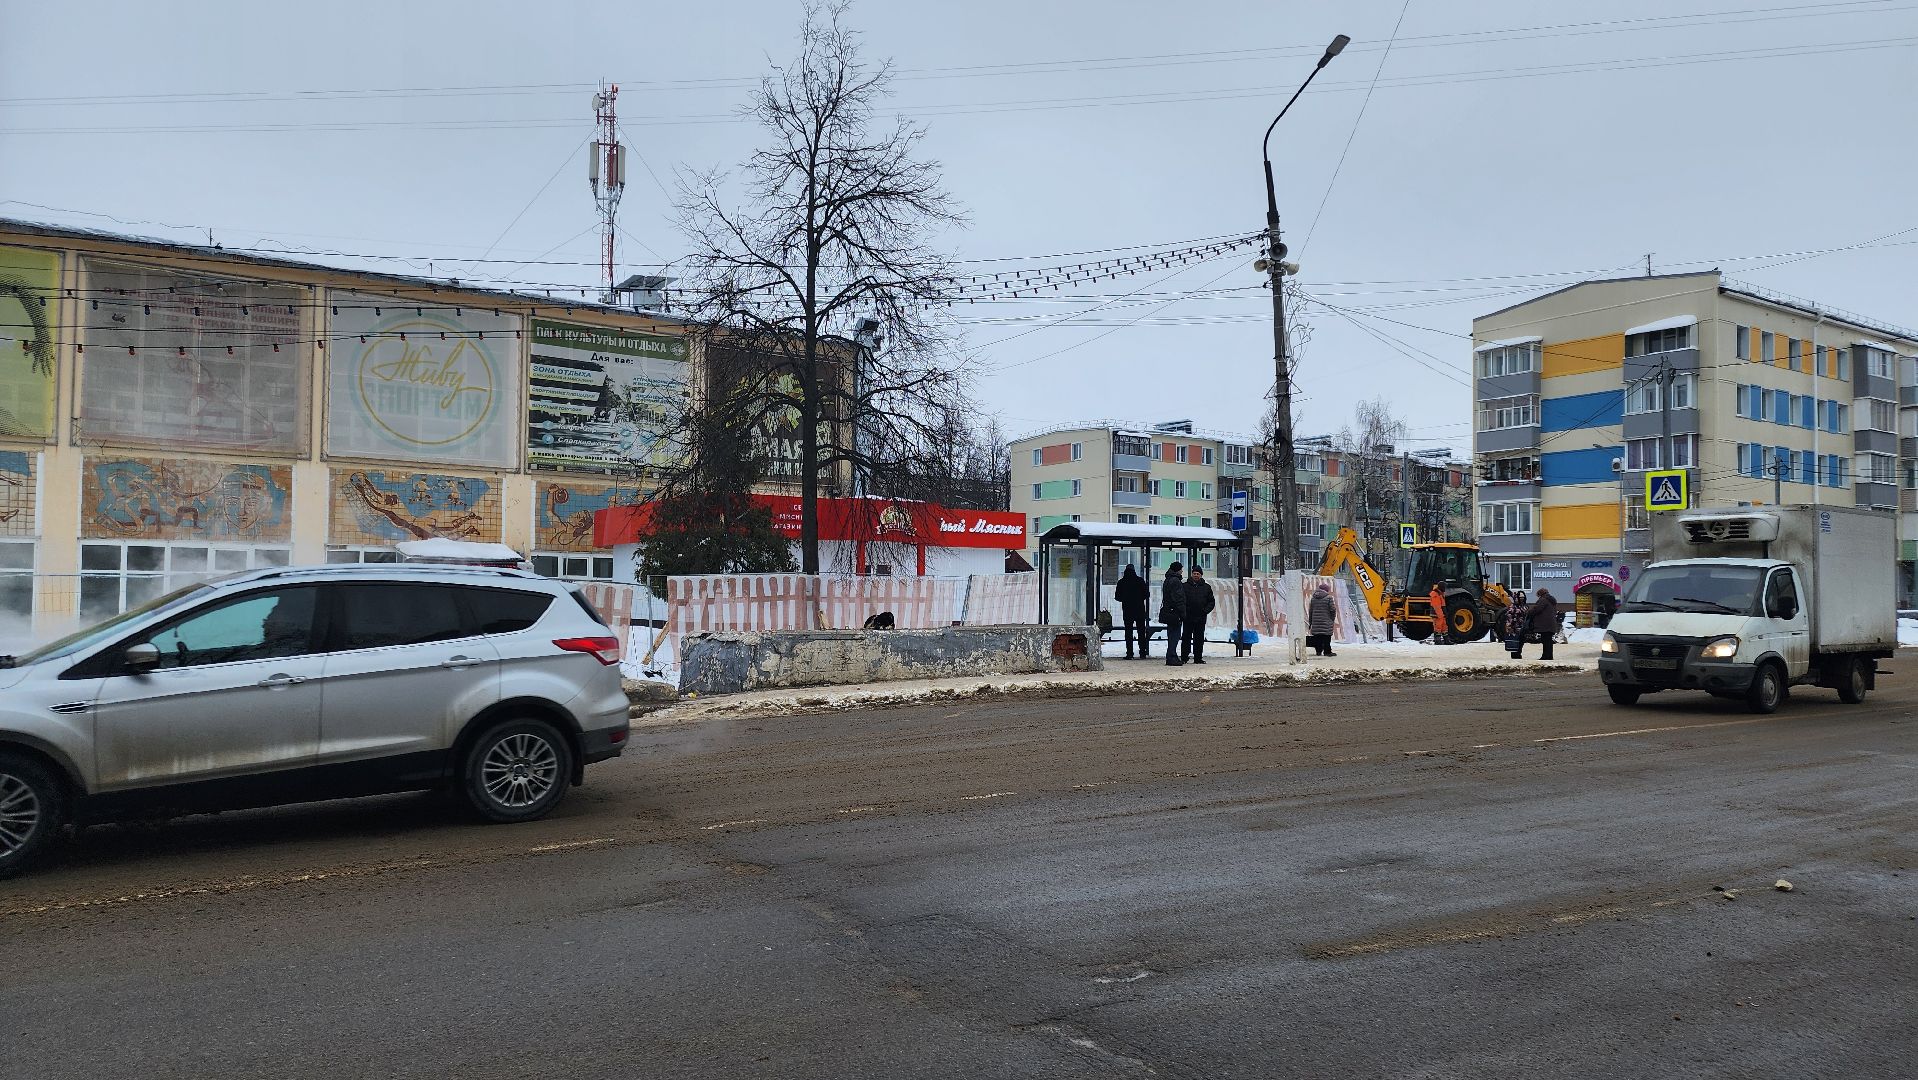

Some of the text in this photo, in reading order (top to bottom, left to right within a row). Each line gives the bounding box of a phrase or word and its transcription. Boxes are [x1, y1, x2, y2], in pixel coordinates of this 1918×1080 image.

[564, 330, 617, 347] КУЛЬТУРЫ
[618, 337, 626, 348] И
[627, 339, 667, 353] ОТДЫХА
[590, 352, 610, 363] Для
[533, 365, 592, 377] ЗОНА ОТДЫХА
[969, 518, 1023, 535] Мясник
[1356, 565, 1374, 590] JCB
[1580, 575, 1612, 584] ПРЕМЬЕР
